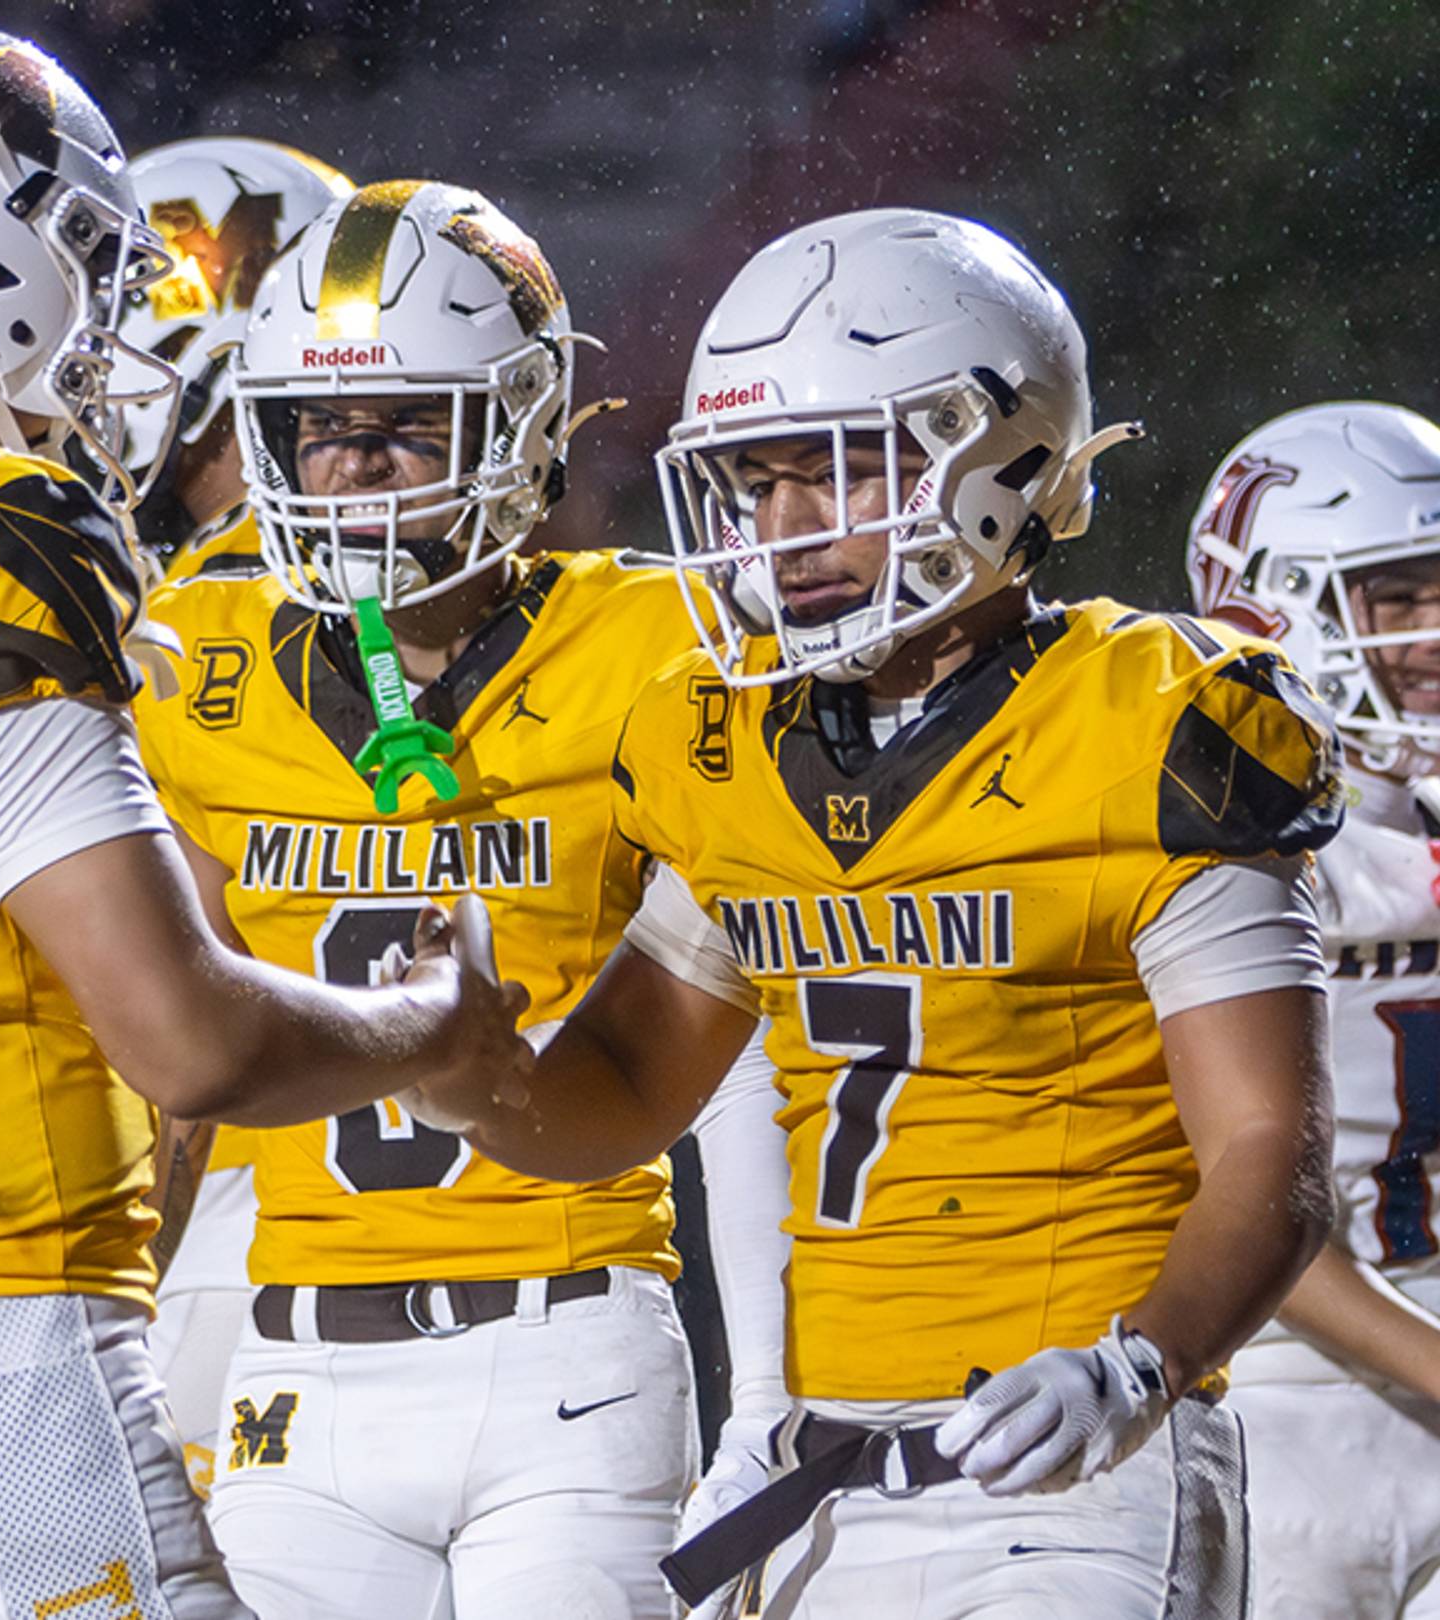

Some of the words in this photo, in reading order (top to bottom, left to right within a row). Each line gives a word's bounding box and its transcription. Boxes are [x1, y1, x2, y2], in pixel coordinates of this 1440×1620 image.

[303, 345, 385, 368] Riddell
[697, 382, 766, 414] Riddell
[240, 817, 552, 893] MILILANI
[716, 889, 1013, 973] MILILANI
[797, 970, 923, 1229] 7
[228, 1391, 299, 1472] M
